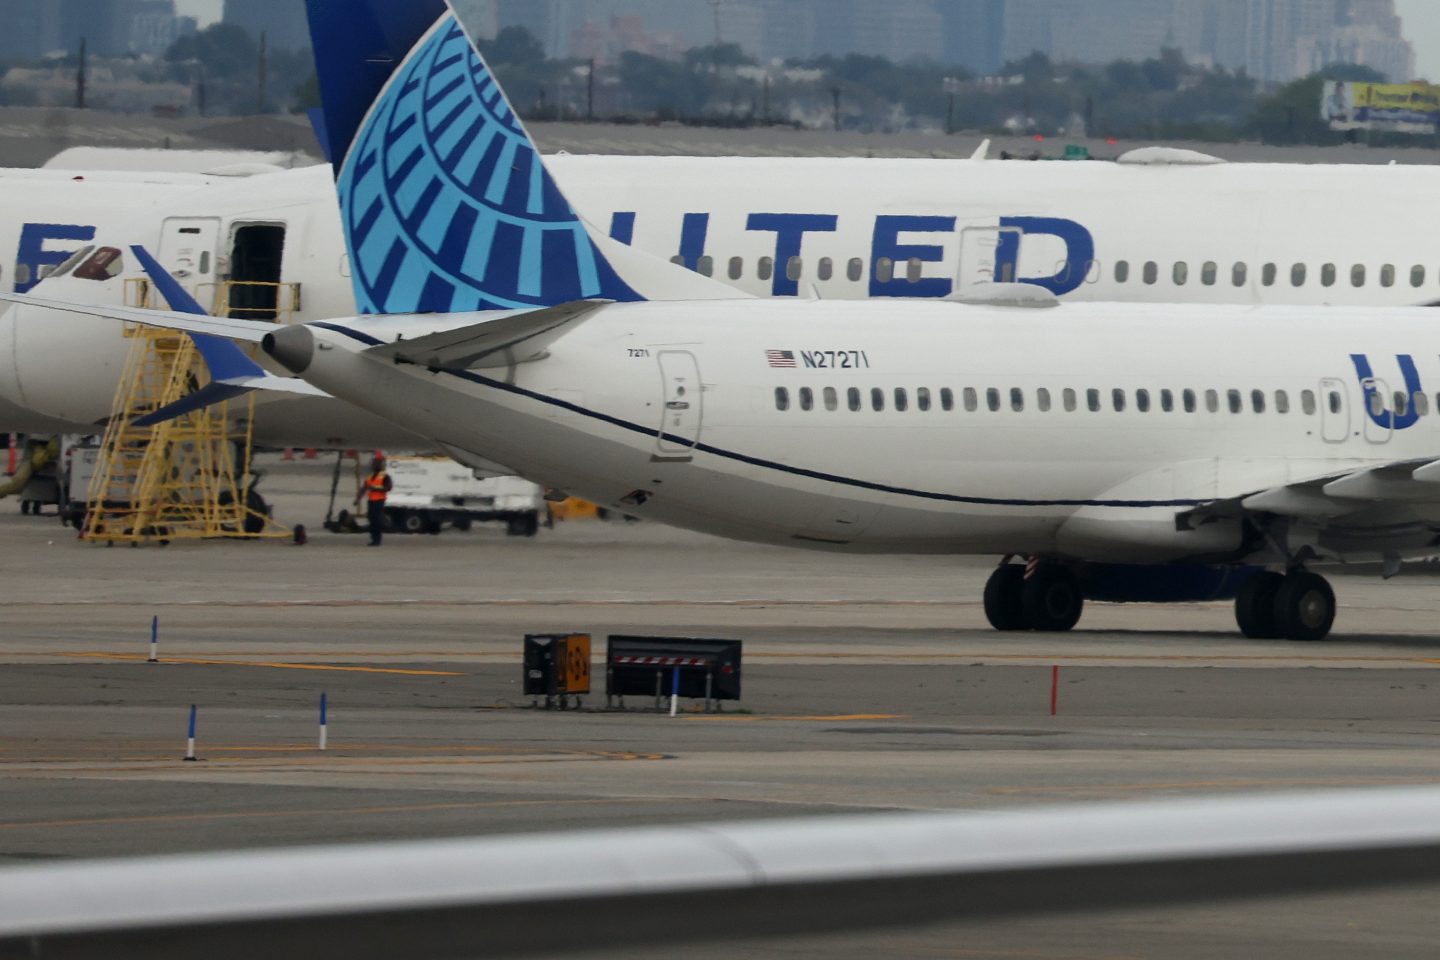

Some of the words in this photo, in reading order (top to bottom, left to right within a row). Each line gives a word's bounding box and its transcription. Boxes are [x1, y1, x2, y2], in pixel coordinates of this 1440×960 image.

[608, 211, 1094, 297] ITED
[626, 348, 649, 358] 7271
[799, 349, 869, 369] N27271
